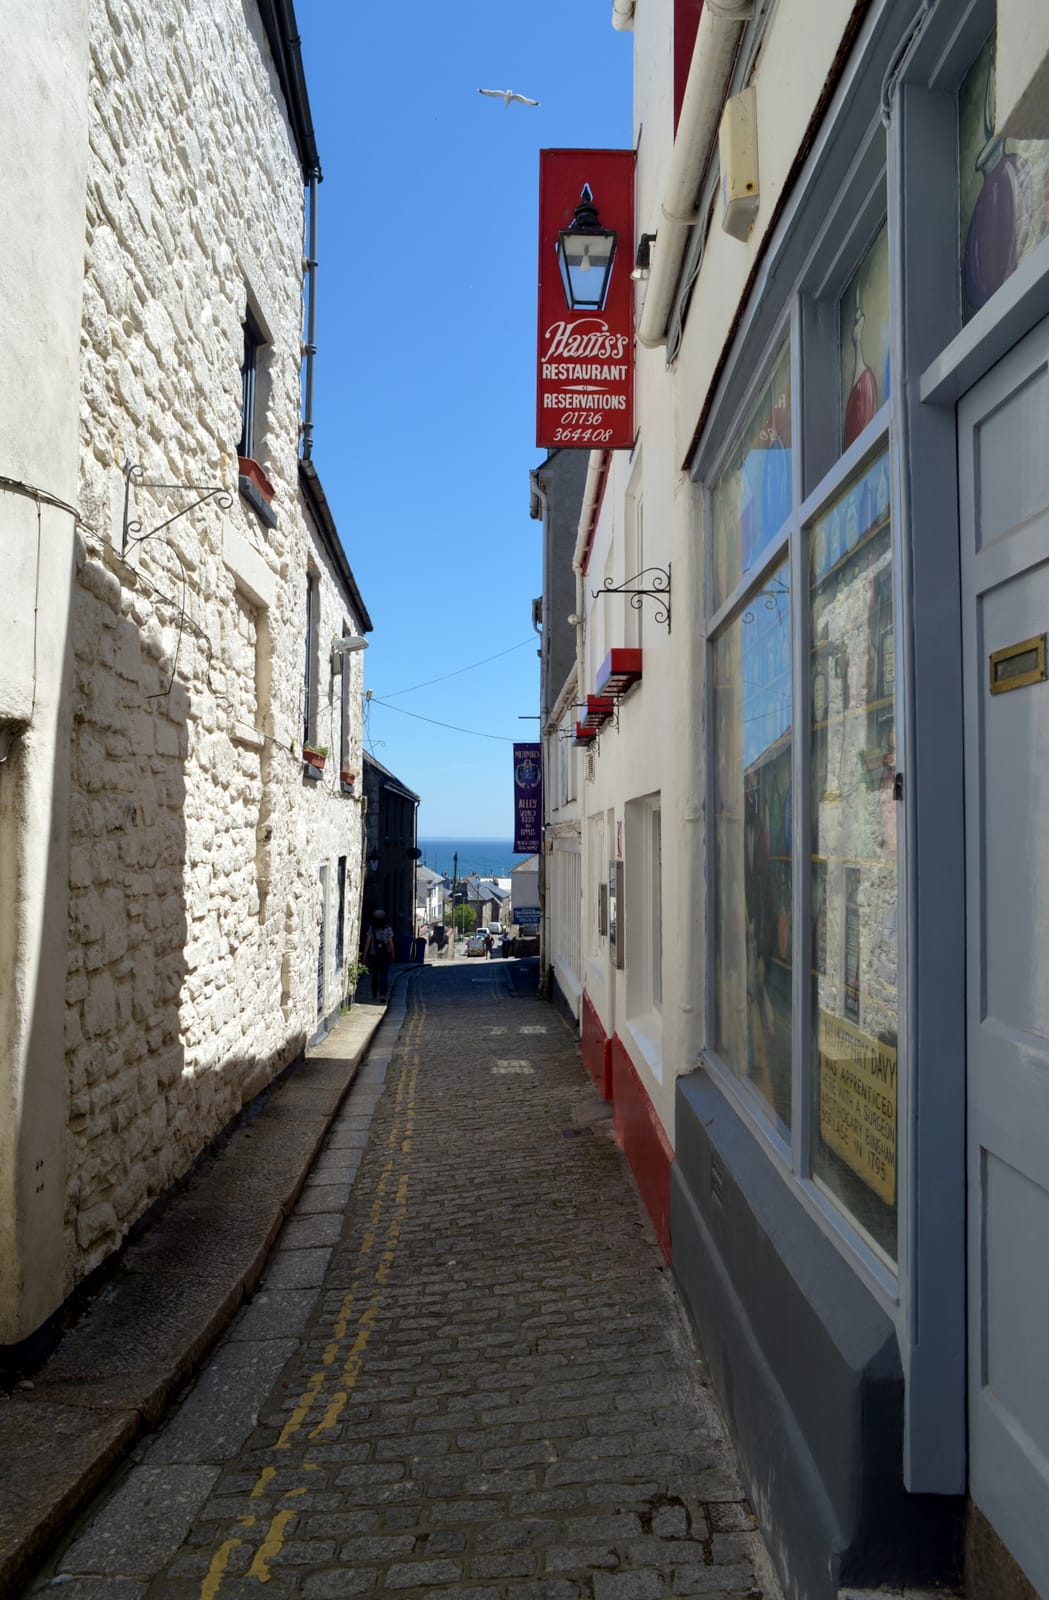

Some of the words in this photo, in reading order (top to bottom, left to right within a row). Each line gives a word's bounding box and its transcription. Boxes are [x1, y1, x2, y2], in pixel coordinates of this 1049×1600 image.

[541, 318, 629, 362] Harris's
[542, 364, 628, 380] RESTAURANT
[543, 393, 627, 410] RESERVATIONS
[561, 411, 602, 425] 01736
[553, 428, 613, 442] 364408
[871, 1046, 896, 1089] DAVY
[841, 1066, 894, 1119] APPRENTICED
[863, 1104, 896, 1145] SURGEON
[854, 1136, 863, 1159] IN
[867, 1150, 886, 1181] 1795
[864, 1127, 896, 1169] BINGHAM
